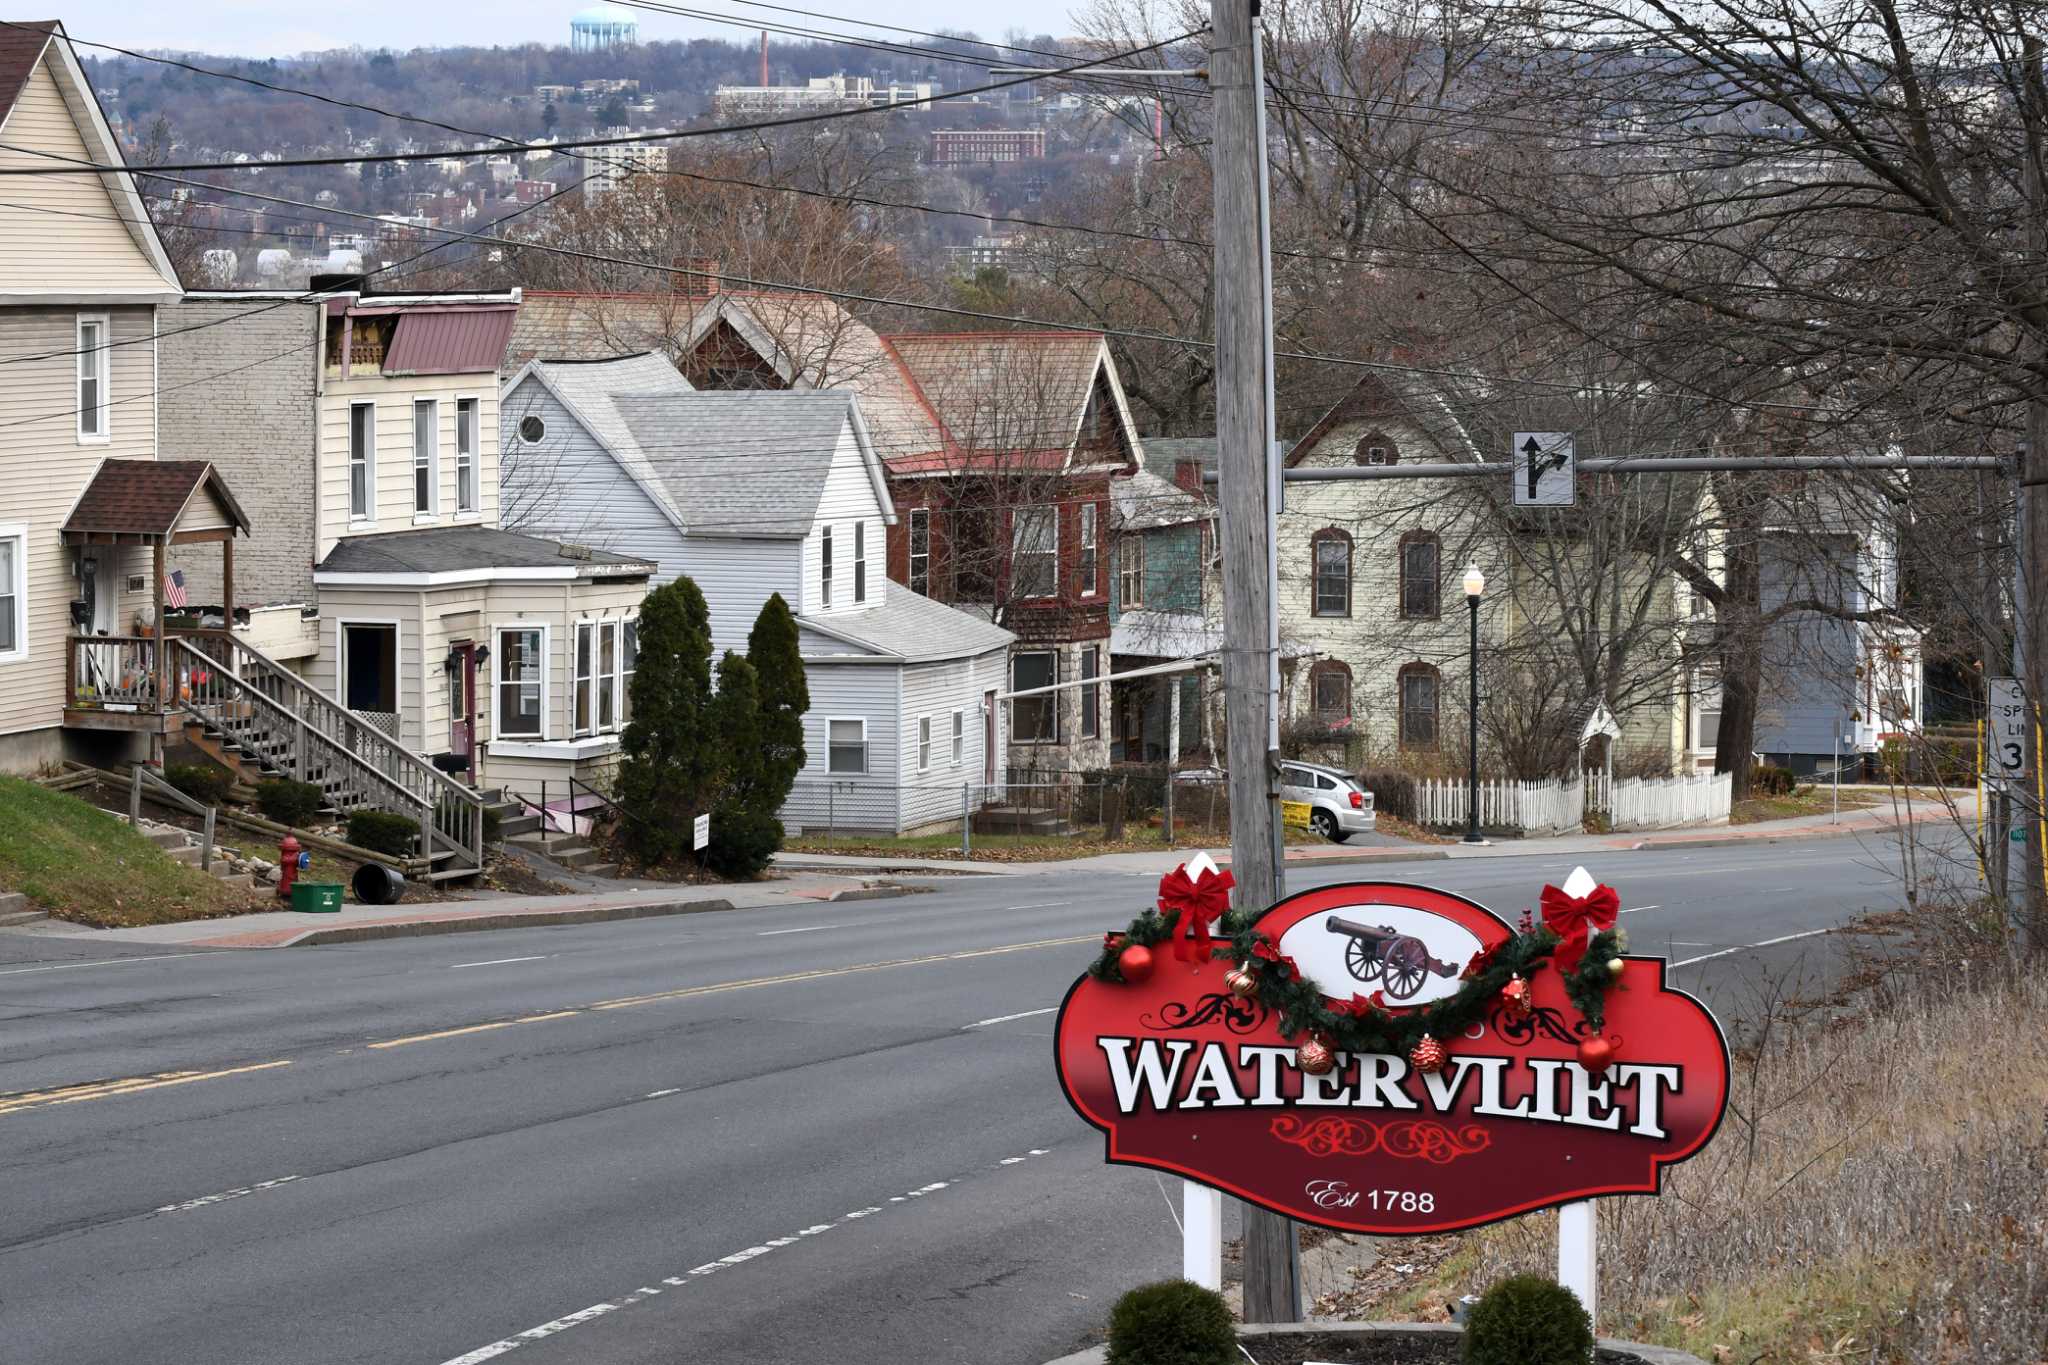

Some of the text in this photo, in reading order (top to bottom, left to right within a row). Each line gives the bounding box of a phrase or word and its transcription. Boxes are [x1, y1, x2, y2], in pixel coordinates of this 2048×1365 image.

[2003, 742, 2023, 770] 3
[1098, 1036, 1679, 1139] WATERVLIET
[1305, 1179, 1435, 1214] Est 1788
